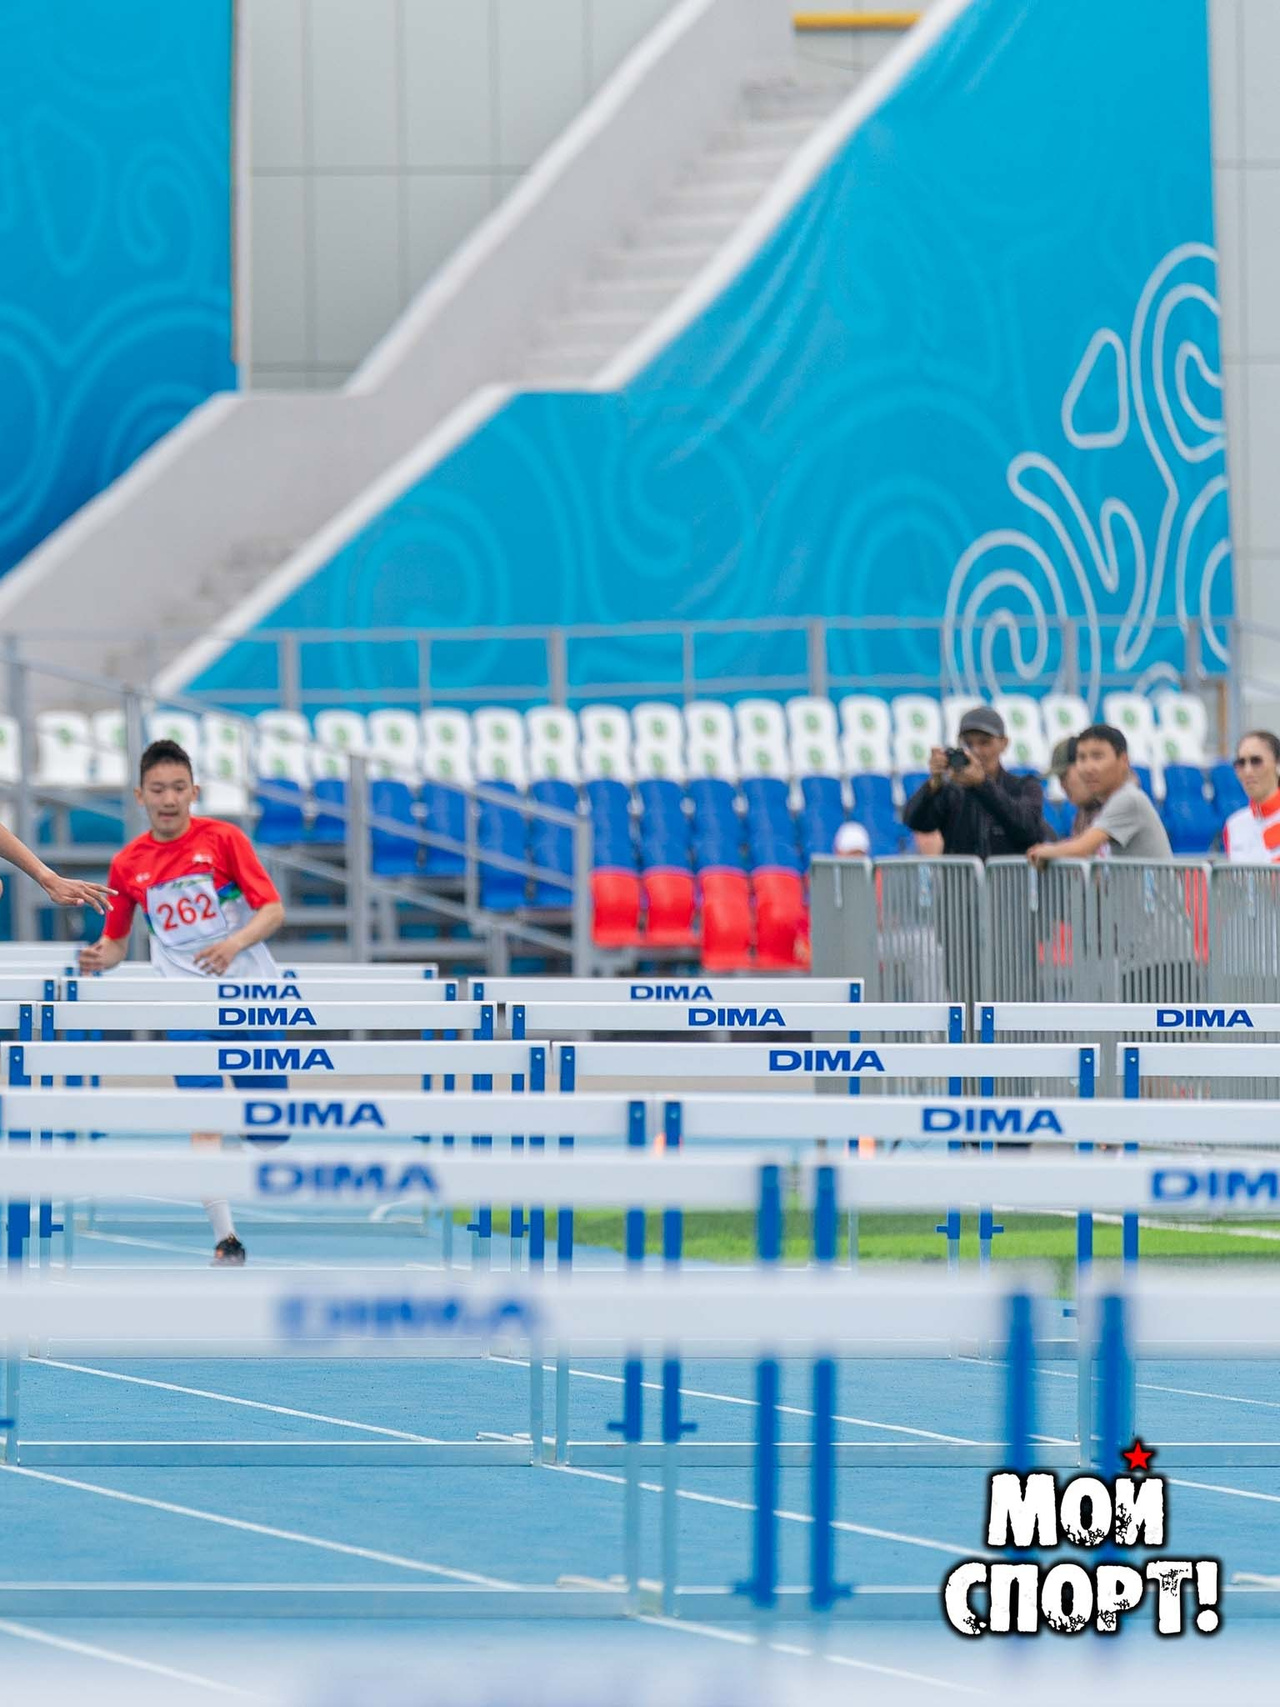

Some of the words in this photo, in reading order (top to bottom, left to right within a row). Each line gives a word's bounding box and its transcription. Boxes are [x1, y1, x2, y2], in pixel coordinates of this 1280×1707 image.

[156, 893, 217, 932] 262
[217, 984, 302, 1000] DIMA
[630, 984, 714, 1000] DIMA
[218, 1007, 317, 1027] DIMA
[688, 1007, 787, 1027] DIMA
[1156, 1009, 1254, 1029] DIMA
[218, 1048, 335, 1071] DIMA
[769, 1050, 886, 1073] DIMA
[244, 1100, 385, 1128] DIMA
[921, 1107, 1064, 1135] DIMA
[256, 1163, 440, 1195] DIMA
[1150, 1169, 1280, 1203] DIM
